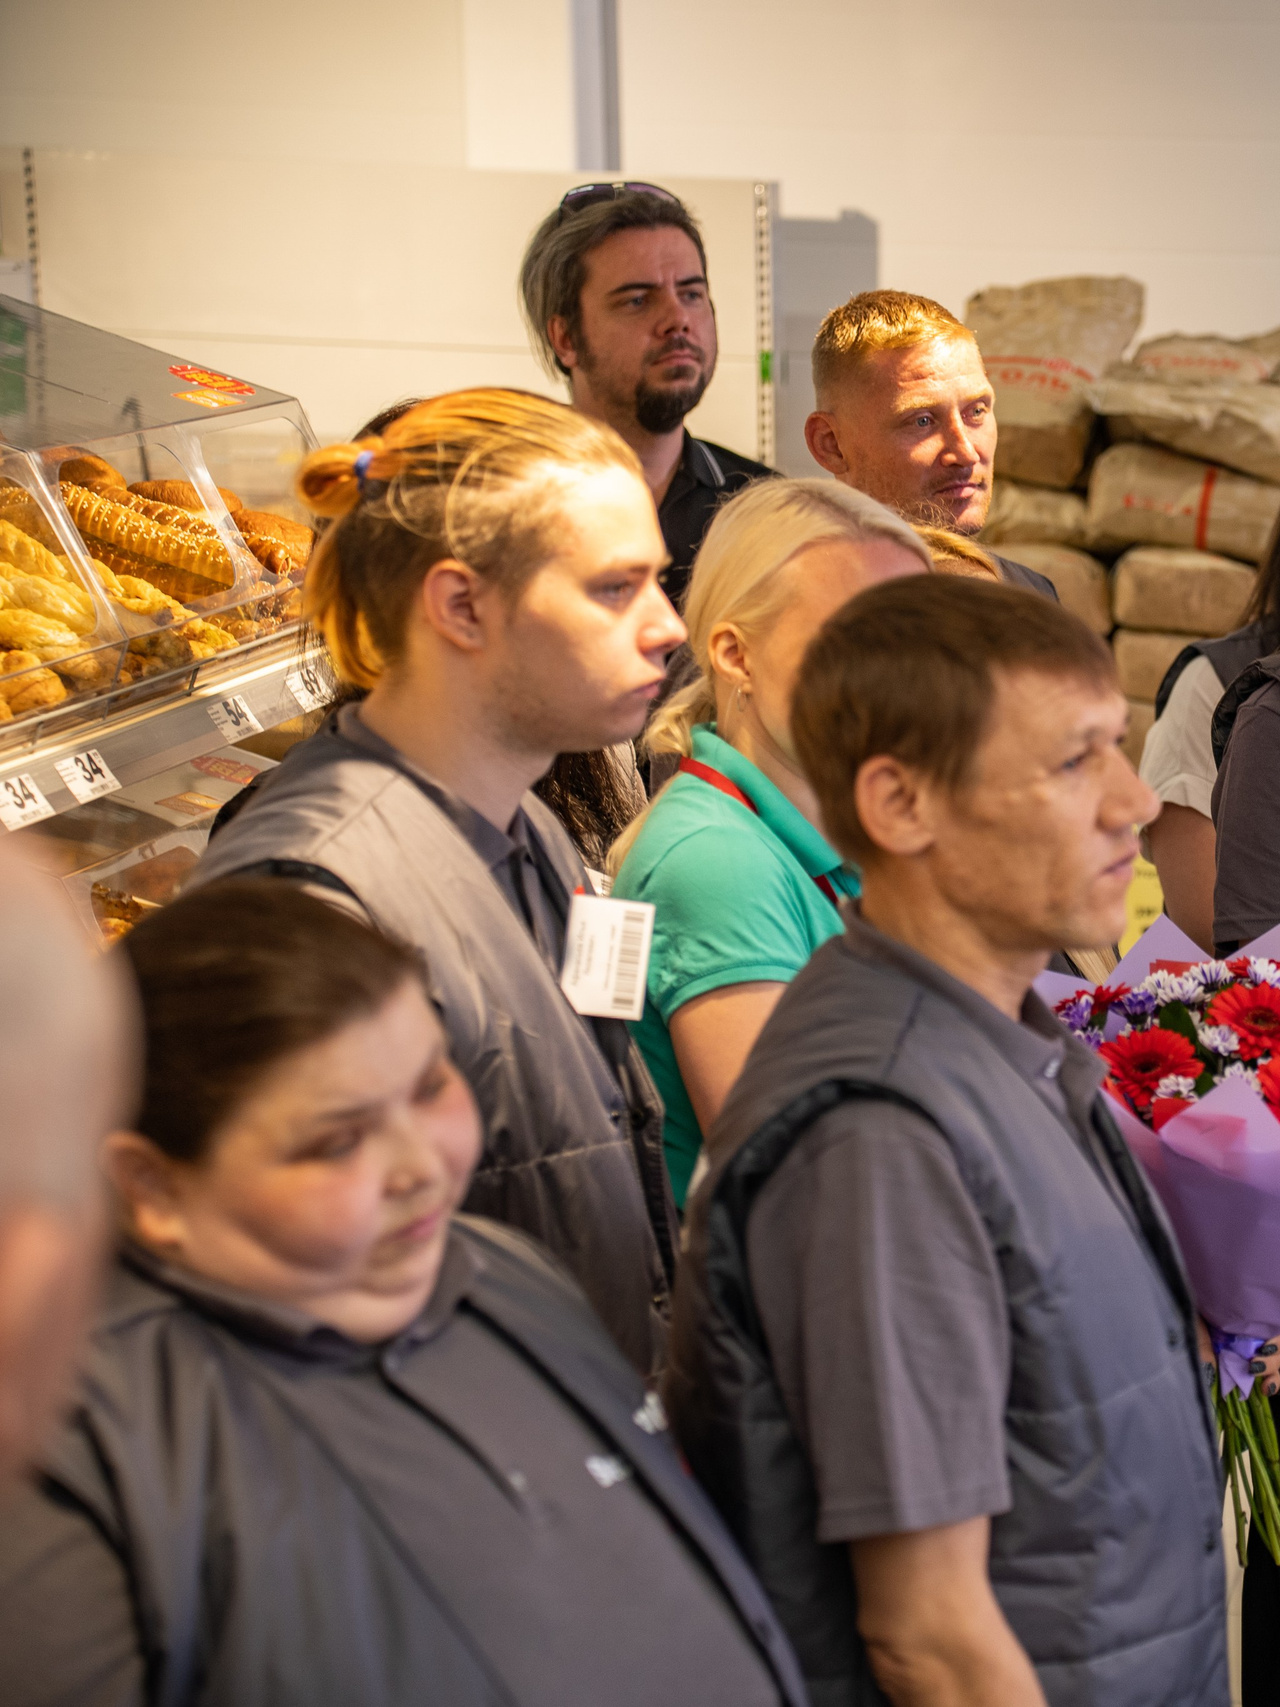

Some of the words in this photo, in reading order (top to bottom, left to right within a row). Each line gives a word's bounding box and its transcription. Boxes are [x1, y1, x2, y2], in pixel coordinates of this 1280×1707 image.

[300, 668, 322, 696] 69
[222, 698, 250, 726] 54
[74, 753, 106, 783] 34
[4, 777, 38, 809] 34
